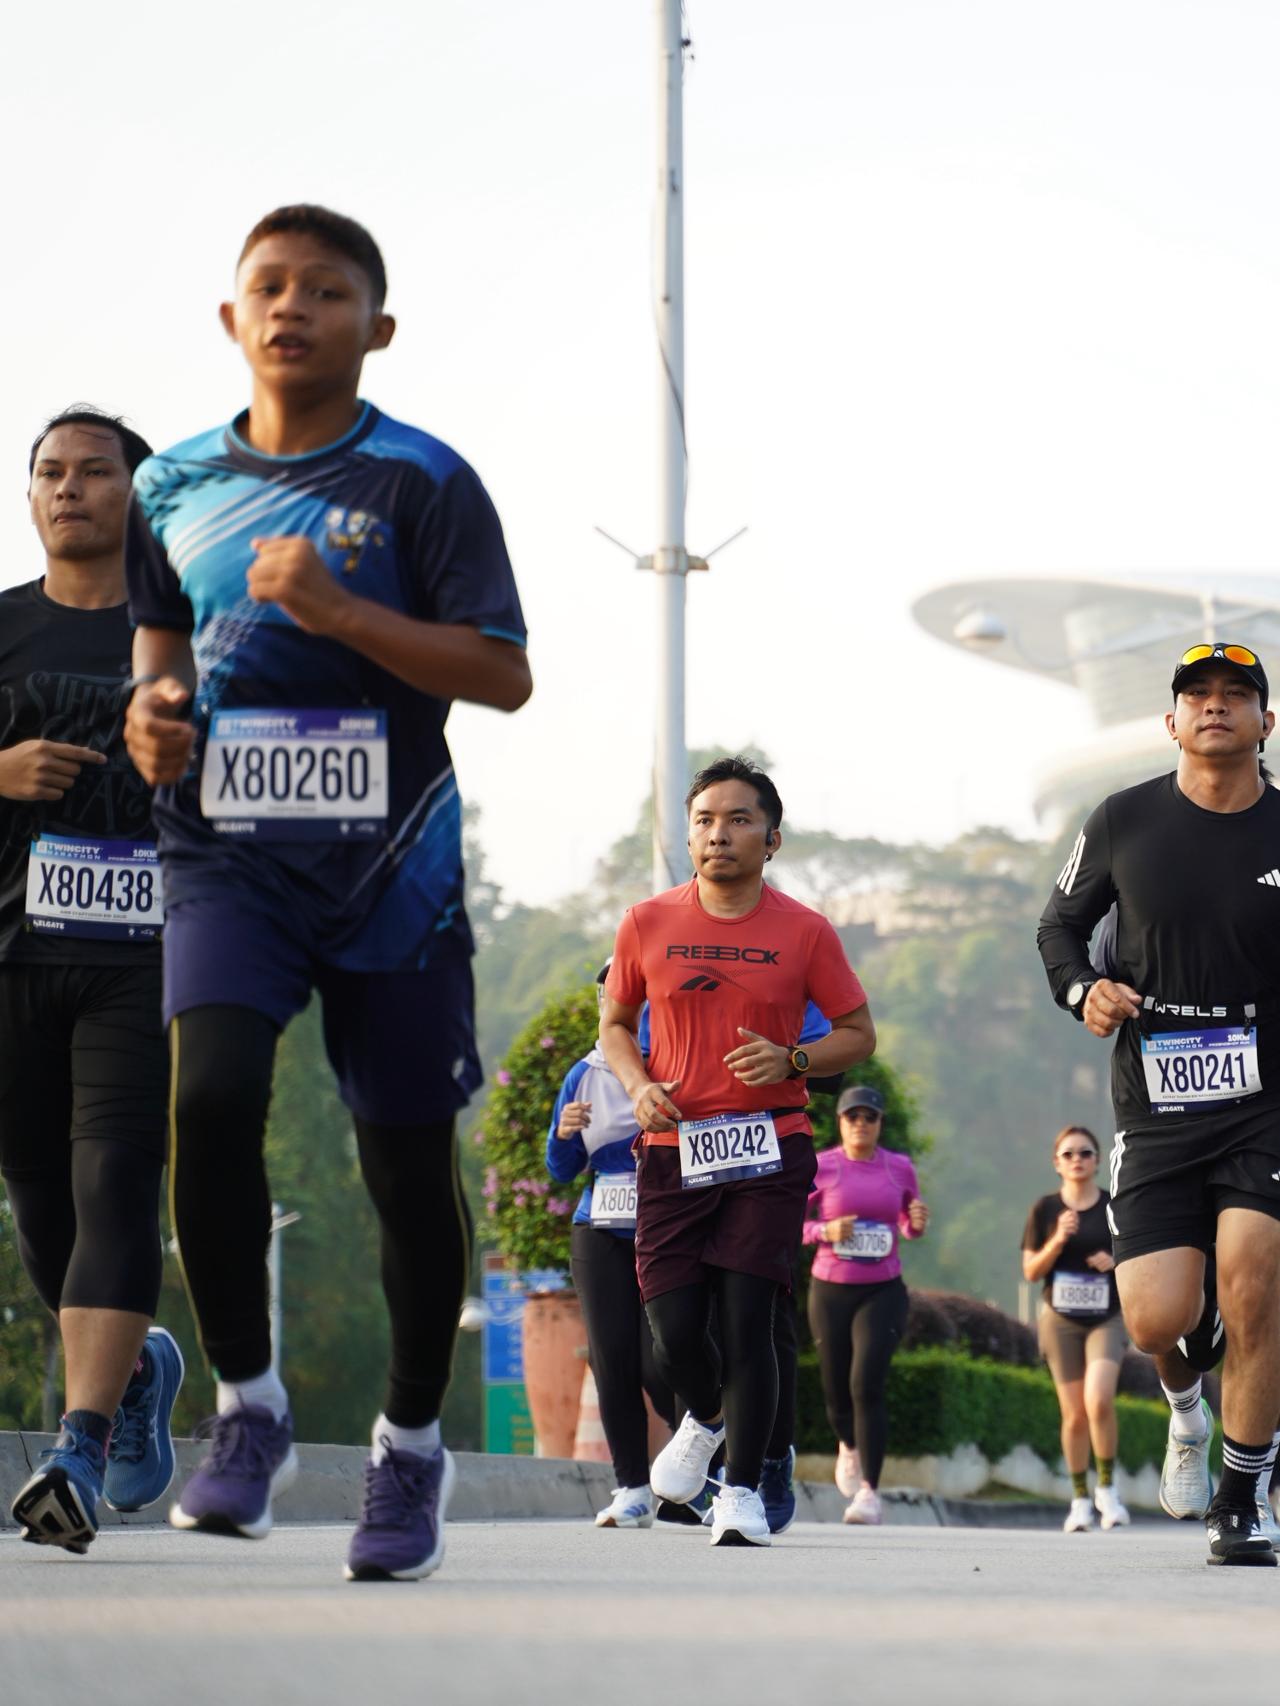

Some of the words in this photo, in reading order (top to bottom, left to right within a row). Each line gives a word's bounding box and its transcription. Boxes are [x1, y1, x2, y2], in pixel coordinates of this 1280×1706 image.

[218, 746, 370, 802] X80260
[47, 842, 101, 854] TWINCITY
[38, 862, 153, 913] X80438
[1157, 1036, 1202, 1046] TWINCITY
[1227, 1033, 1250, 1042] 10KM
[1156, 1052, 1247, 1093] X80241
[688, 1124, 769, 1167] X80242
